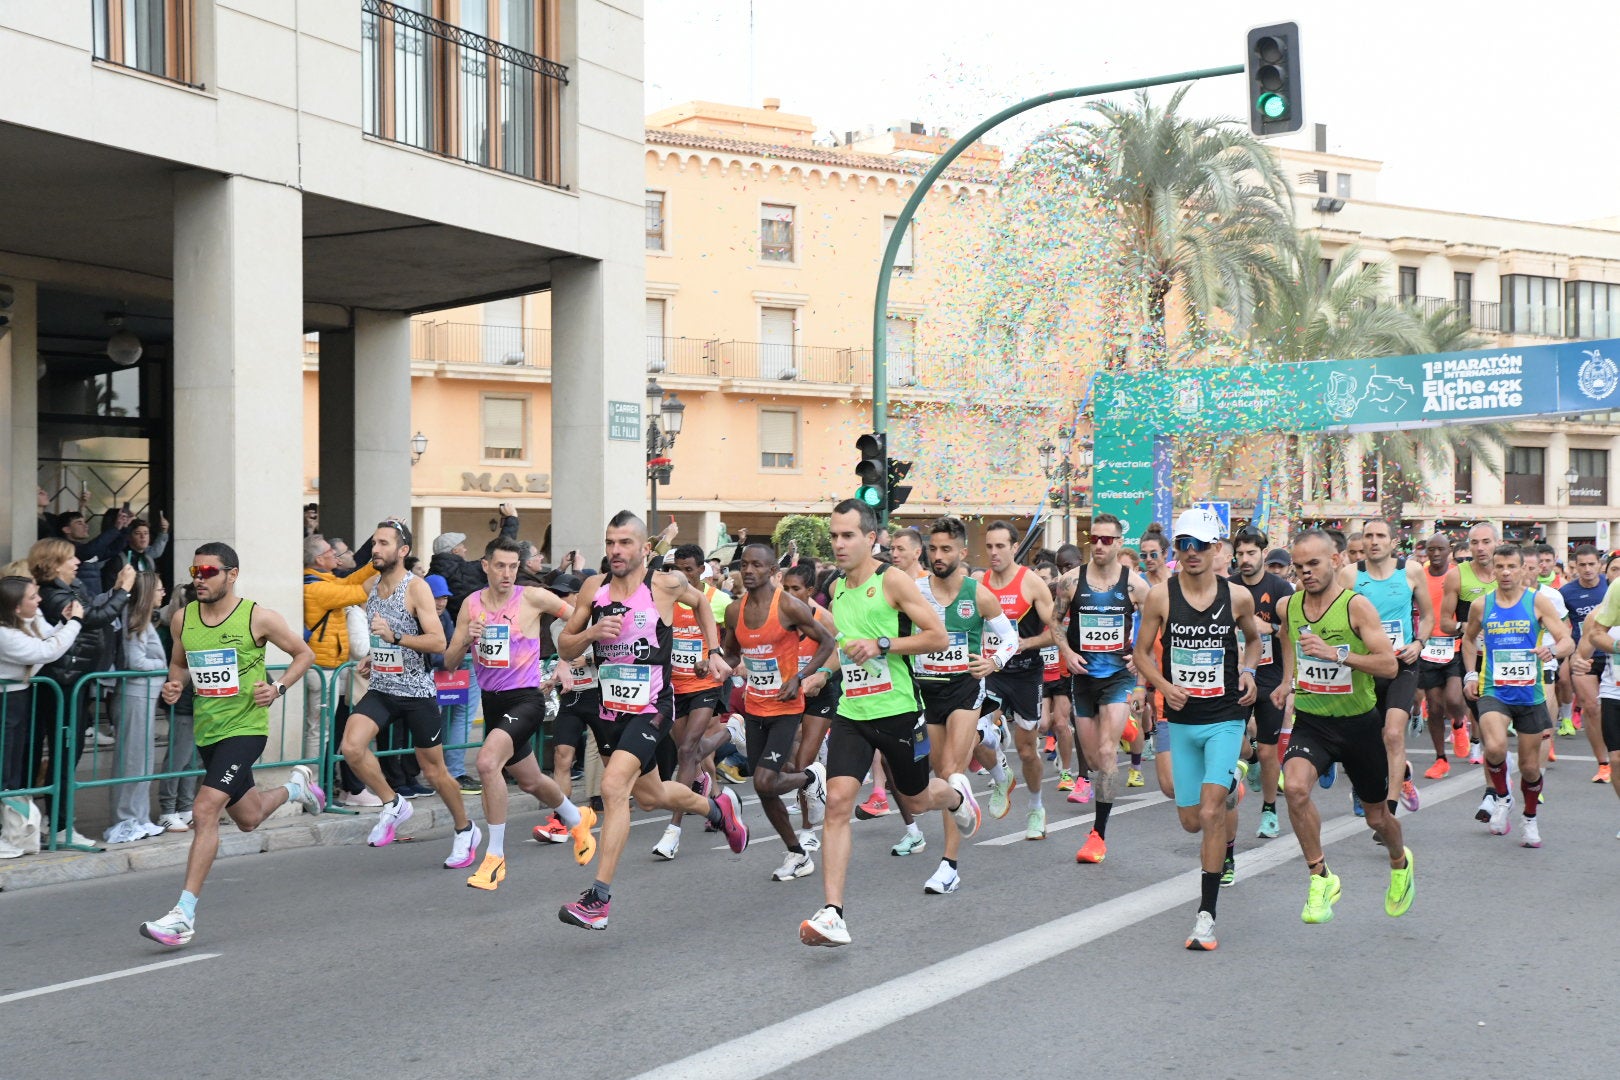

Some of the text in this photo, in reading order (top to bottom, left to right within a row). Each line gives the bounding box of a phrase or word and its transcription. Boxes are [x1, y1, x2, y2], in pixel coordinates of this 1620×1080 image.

[1444, 353, 1522, 372] MARATÓN
[1444, 366, 1522, 379] INTERNACIONAL
[1423, 378, 1522, 397] Elche 42K
[615, 403, 639, 414] CARRER
[1422, 391, 1523, 413] Alicante
[1085, 631, 1119, 641] 4206
[1171, 623, 1231, 637] Koryo Car
[1171, 635, 1223, 648] Hyundai
[373, 652, 395, 662] 3371
[671, 653, 697, 665] 4239
[927, 650, 963, 661] 4248
[196, 670, 231, 684] 3550
[1178, 670, 1216, 683] 3795
[1306, 666, 1339, 680] 4117
[1501, 666, 1530, 676] 3451
[749, 675, 775, 686] 4237
[610, 684, 640, 699] 1827
